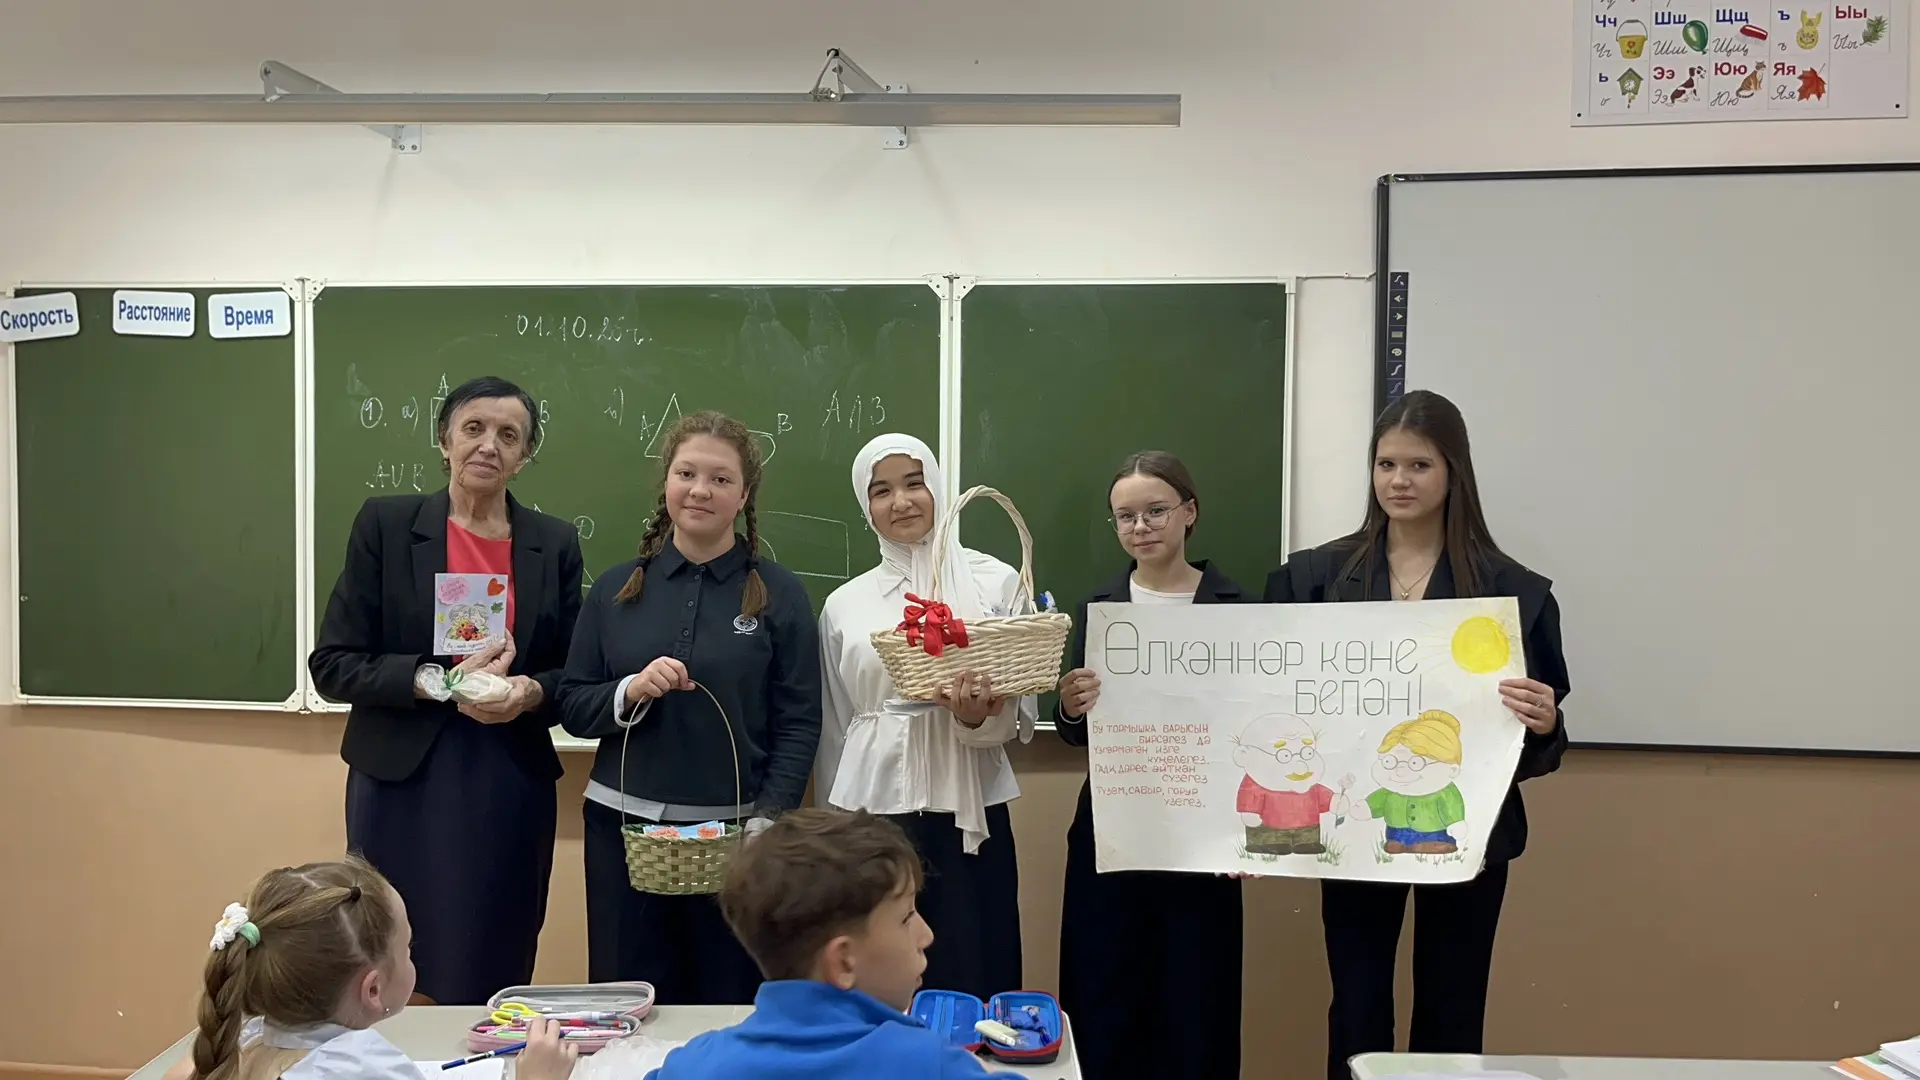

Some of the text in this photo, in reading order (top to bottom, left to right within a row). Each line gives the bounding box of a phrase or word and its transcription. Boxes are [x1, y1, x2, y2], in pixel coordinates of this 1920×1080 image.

[1654, 11, 1687, 26] Шш
[1716, 8, 1749, 24] Щщ
[1835, 5, 1867, 20] Ыы
[1595, 14, 1617, 28] Чч
[1652, 66, 1676, 81] Ээ
[1714, 62, 1748, 77] Юю
[1773, 62, 1796, 77] Яя
[118, 299, 191, 323] Расстояние
[224, 305, 274, 331] Время
[0, 307, 74, 333] Скорость
